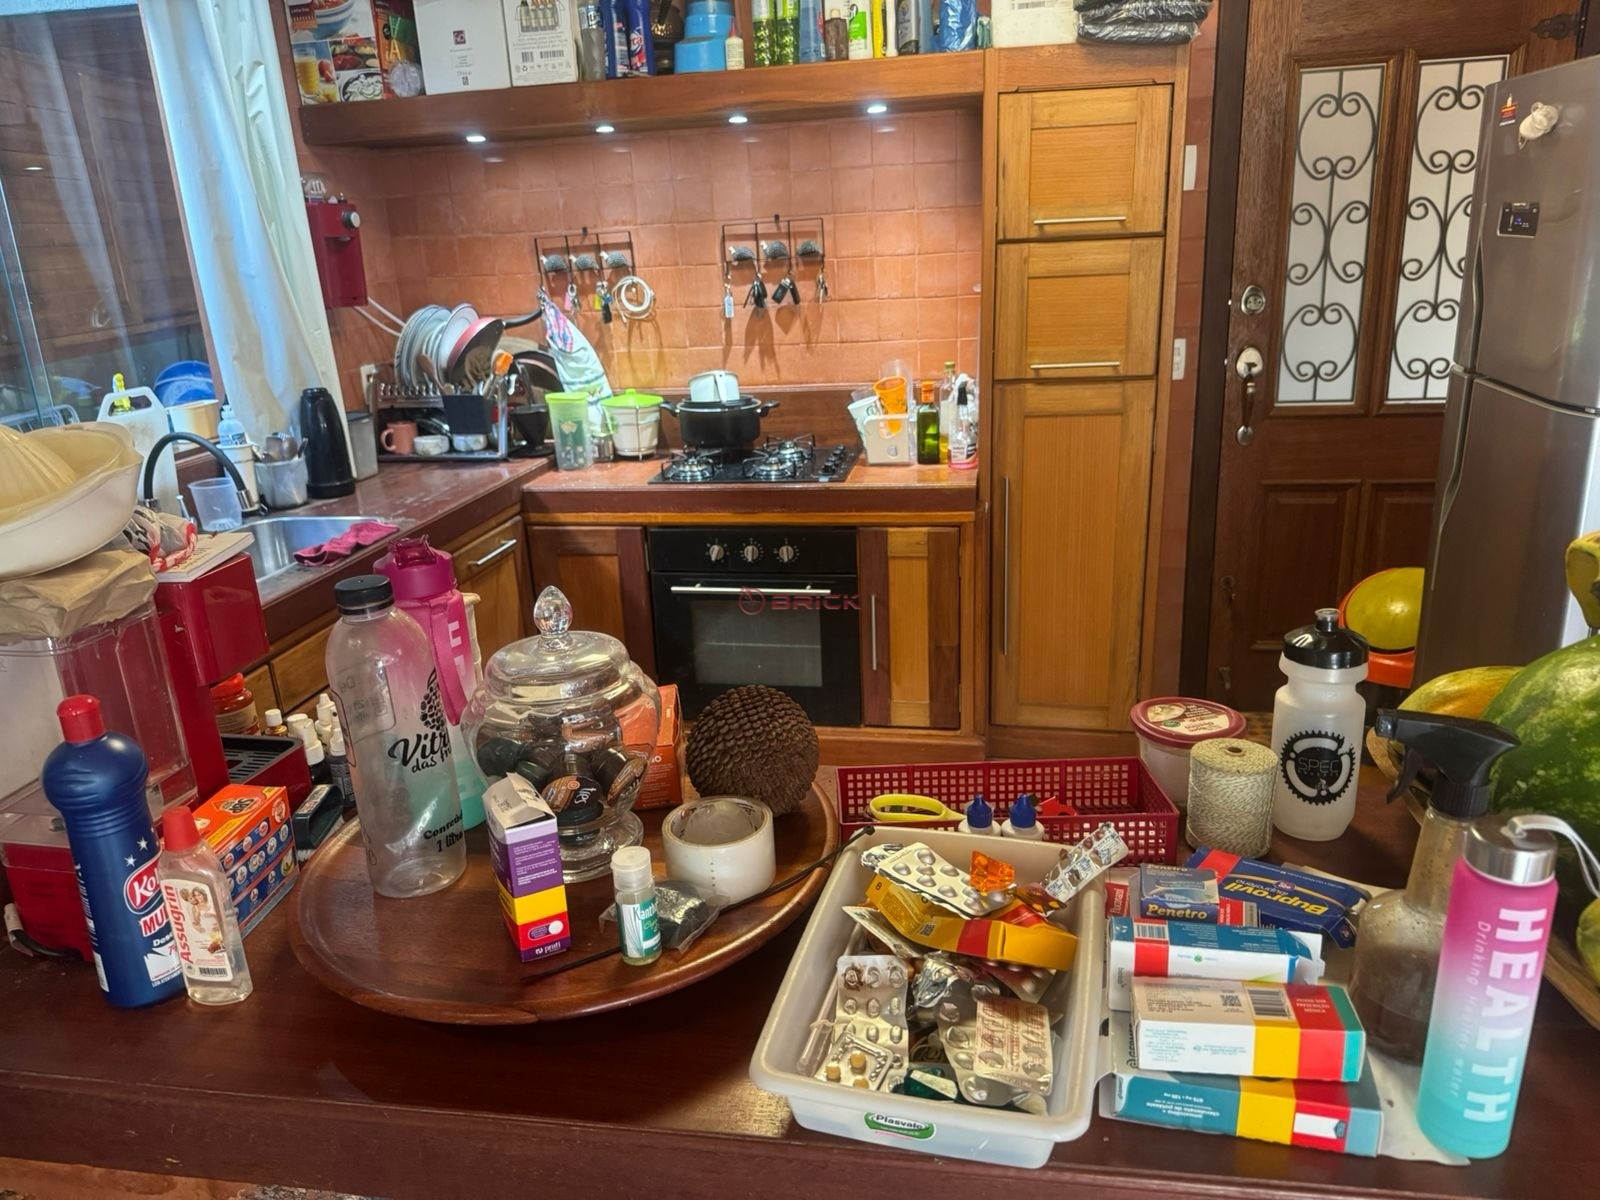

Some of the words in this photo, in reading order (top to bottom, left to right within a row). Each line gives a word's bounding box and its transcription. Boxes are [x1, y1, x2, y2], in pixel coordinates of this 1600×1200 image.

[411, 756, 438, 774] das
[1299, 757, 1339, 774] SPEC
[1146, 903, 1208, 920] Penetro
[1223, 881, 1329, 916] Buprovil
[164, 885, 194, 965] Assugrin
[1465, 920, 1492, 987] Drinking
[1463, 907, 1548, 1123] HEALTH
